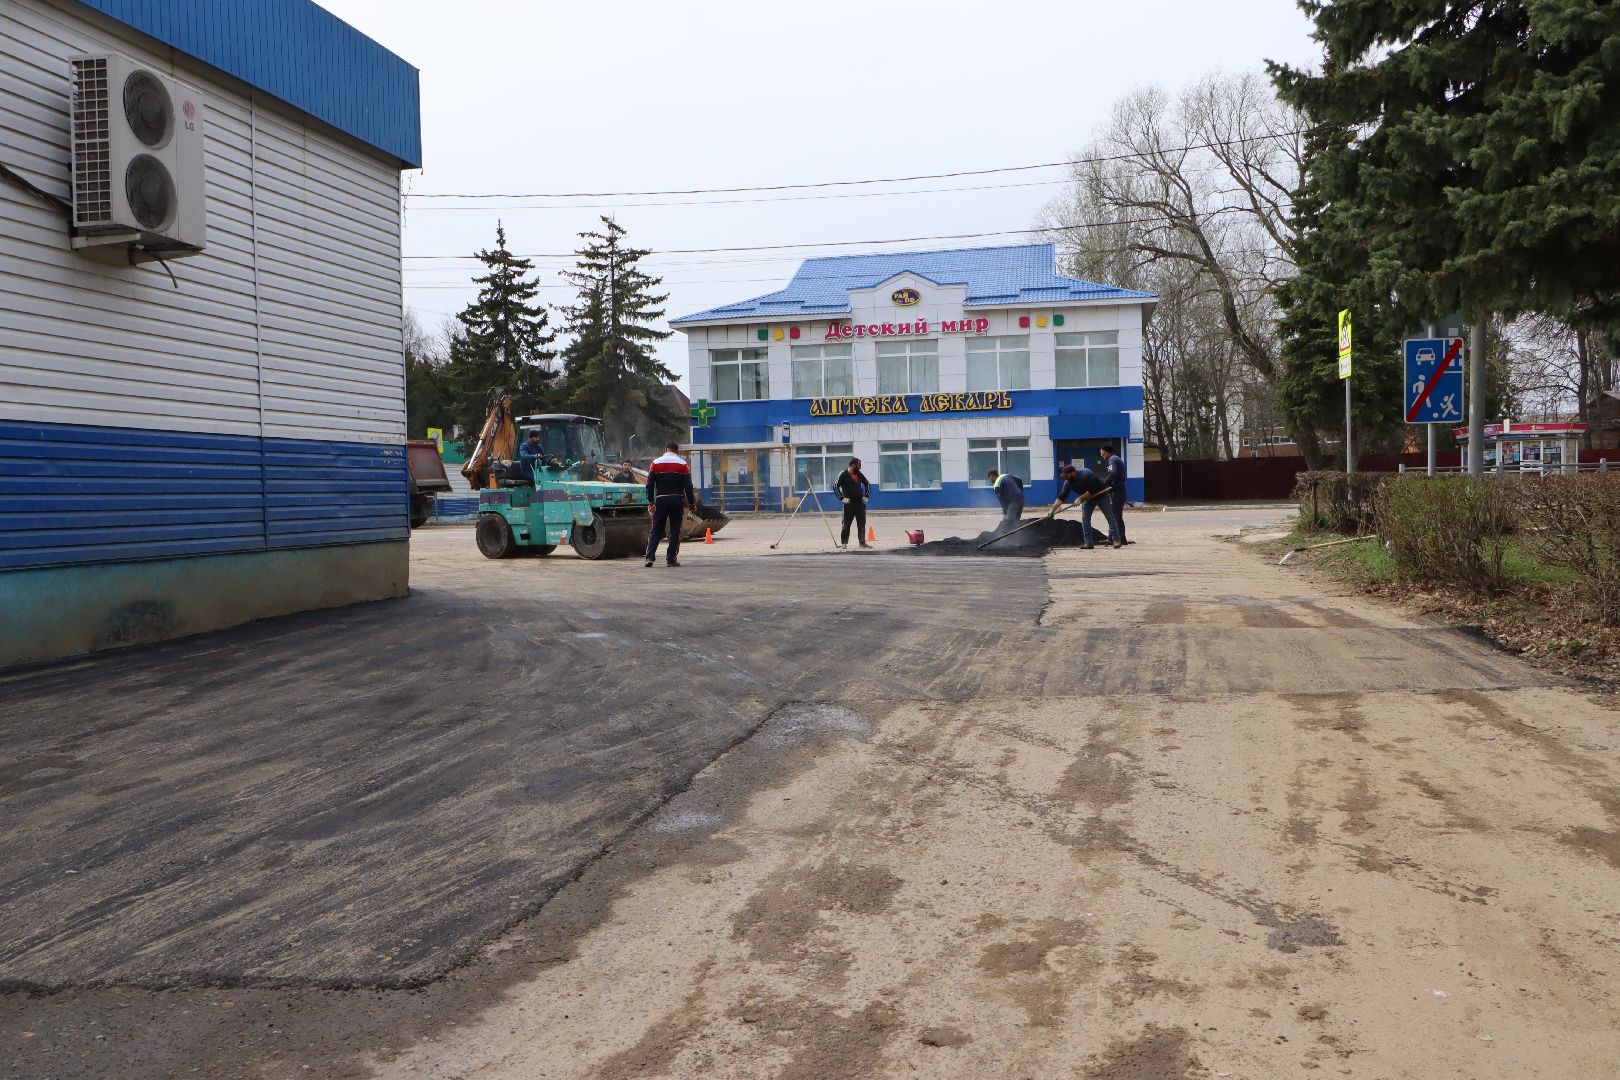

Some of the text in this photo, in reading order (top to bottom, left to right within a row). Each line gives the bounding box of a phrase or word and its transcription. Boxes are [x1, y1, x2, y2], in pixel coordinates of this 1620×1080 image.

[184, 120, 194, 131] LG
[824, 317, 989, 340] Детский мир
[810, 391, 1011, 416] АПТЕКА ЛЕКАРЬ
